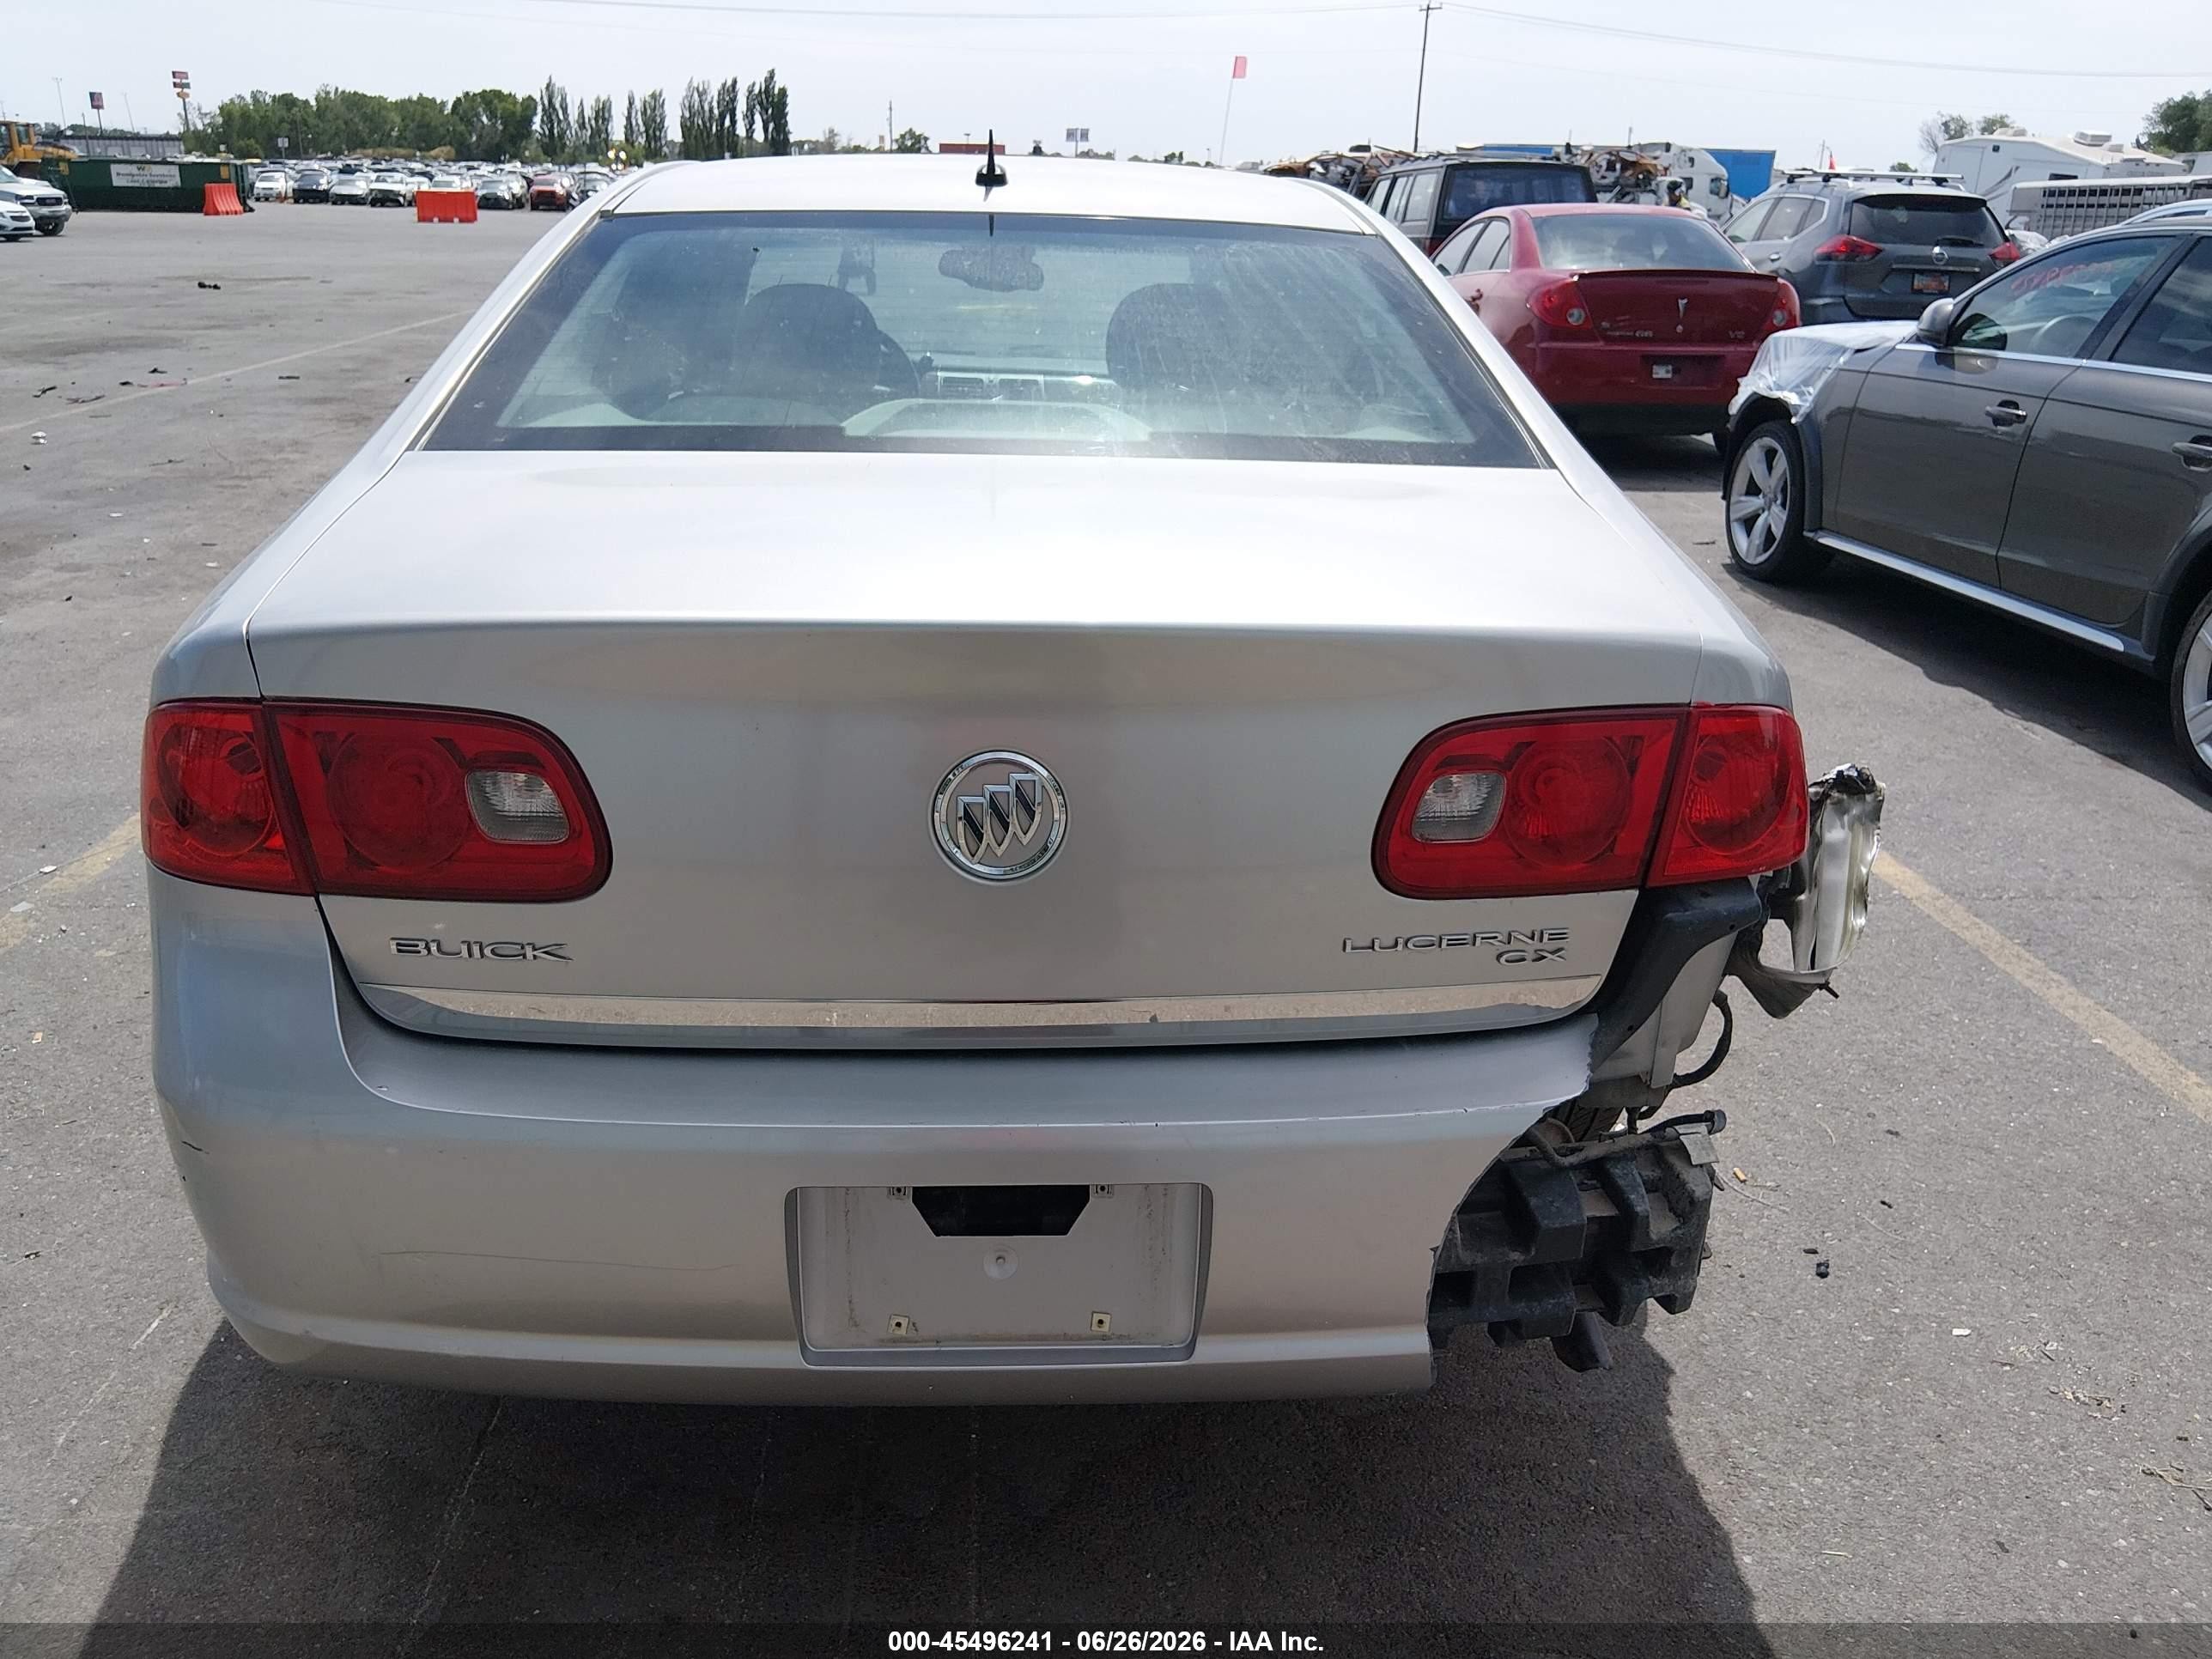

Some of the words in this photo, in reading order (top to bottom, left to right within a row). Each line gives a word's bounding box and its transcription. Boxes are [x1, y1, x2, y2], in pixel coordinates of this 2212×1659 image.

[389, 937, 574, 962] BUICK
[1342, 927, 1570, 953] LUCERNE
[1496, 947, 1567, 966] CX
